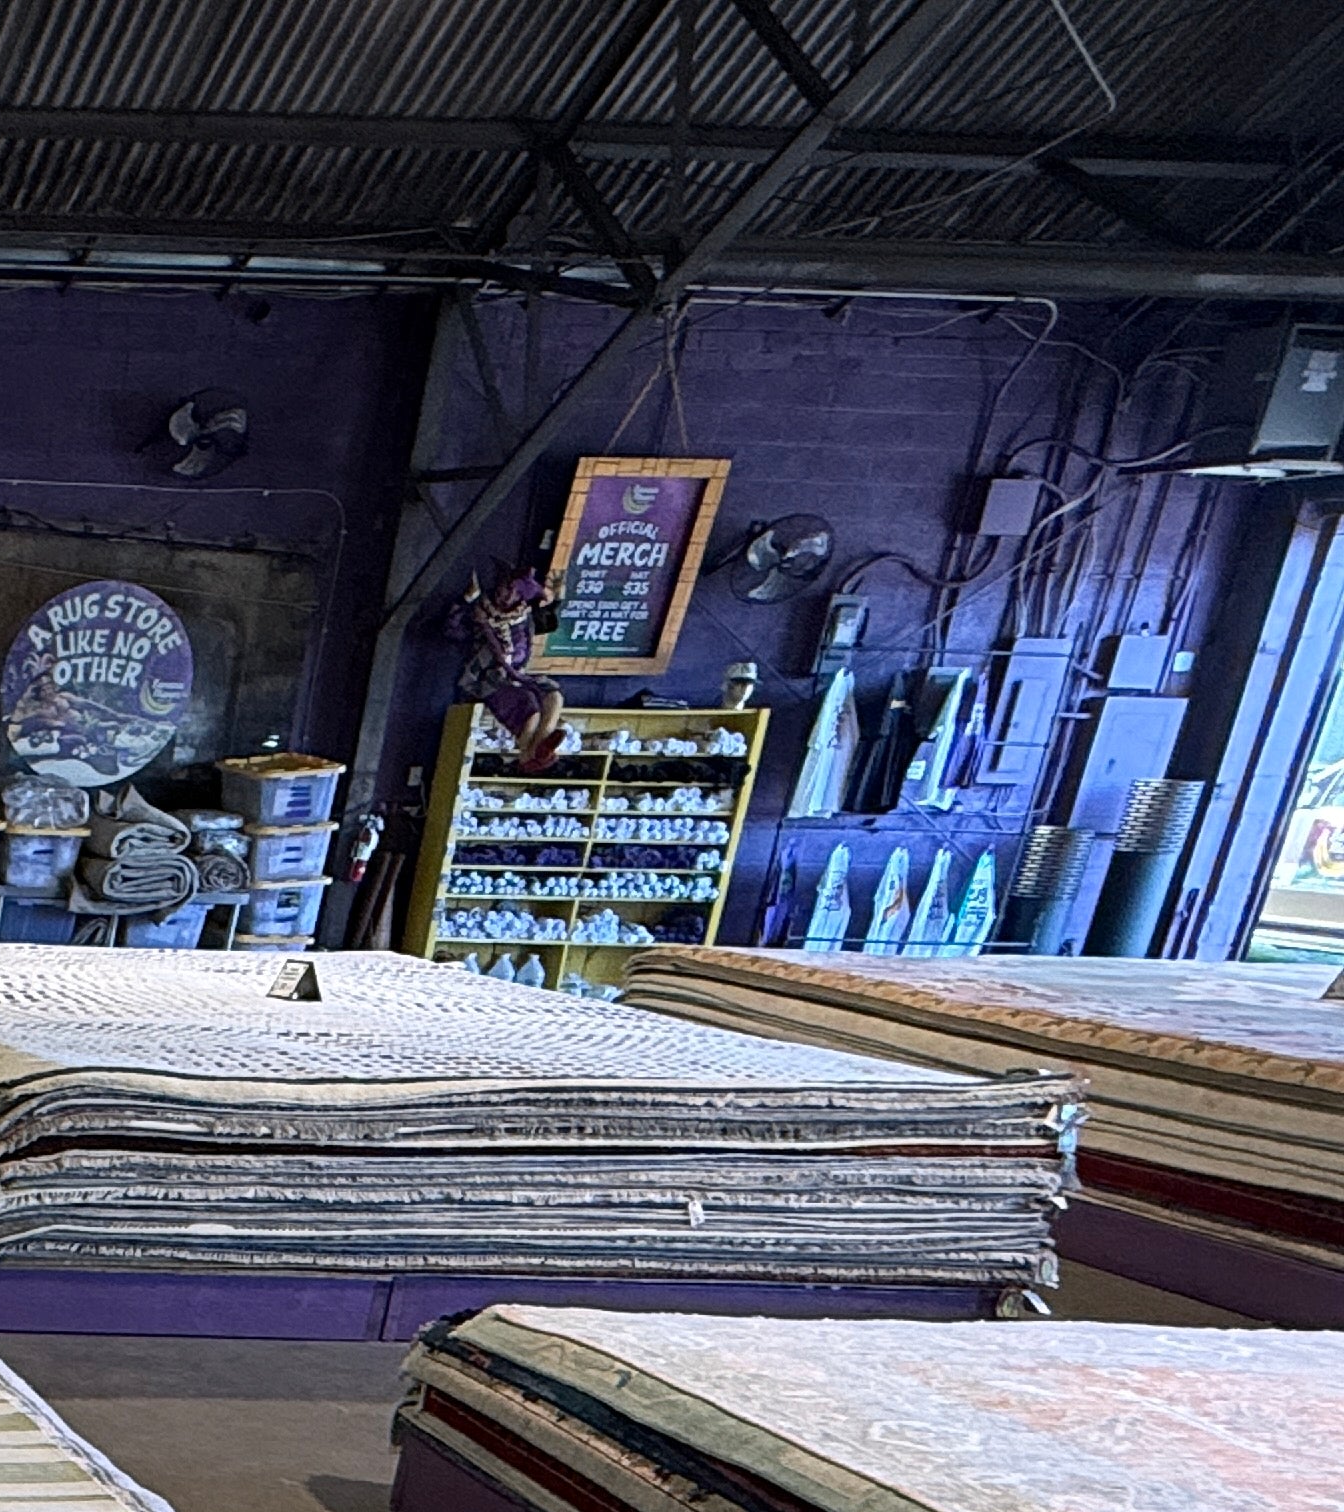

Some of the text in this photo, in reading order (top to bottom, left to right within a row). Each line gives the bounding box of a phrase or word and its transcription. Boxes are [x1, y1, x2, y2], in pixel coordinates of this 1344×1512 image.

[598, 521, 660, 540] OFFICIAL
[576, 542, 670, 568] MERCH
[576, 580, 604, 595] $30
[622, 581, 651, 597] $35
[28, 593, 183, 655] A RUG STORE
[570, 620, 630, 642] FREE
[56, 629, 152, 660] LIKE NO
[52, 656, 143, 688] OTHER
